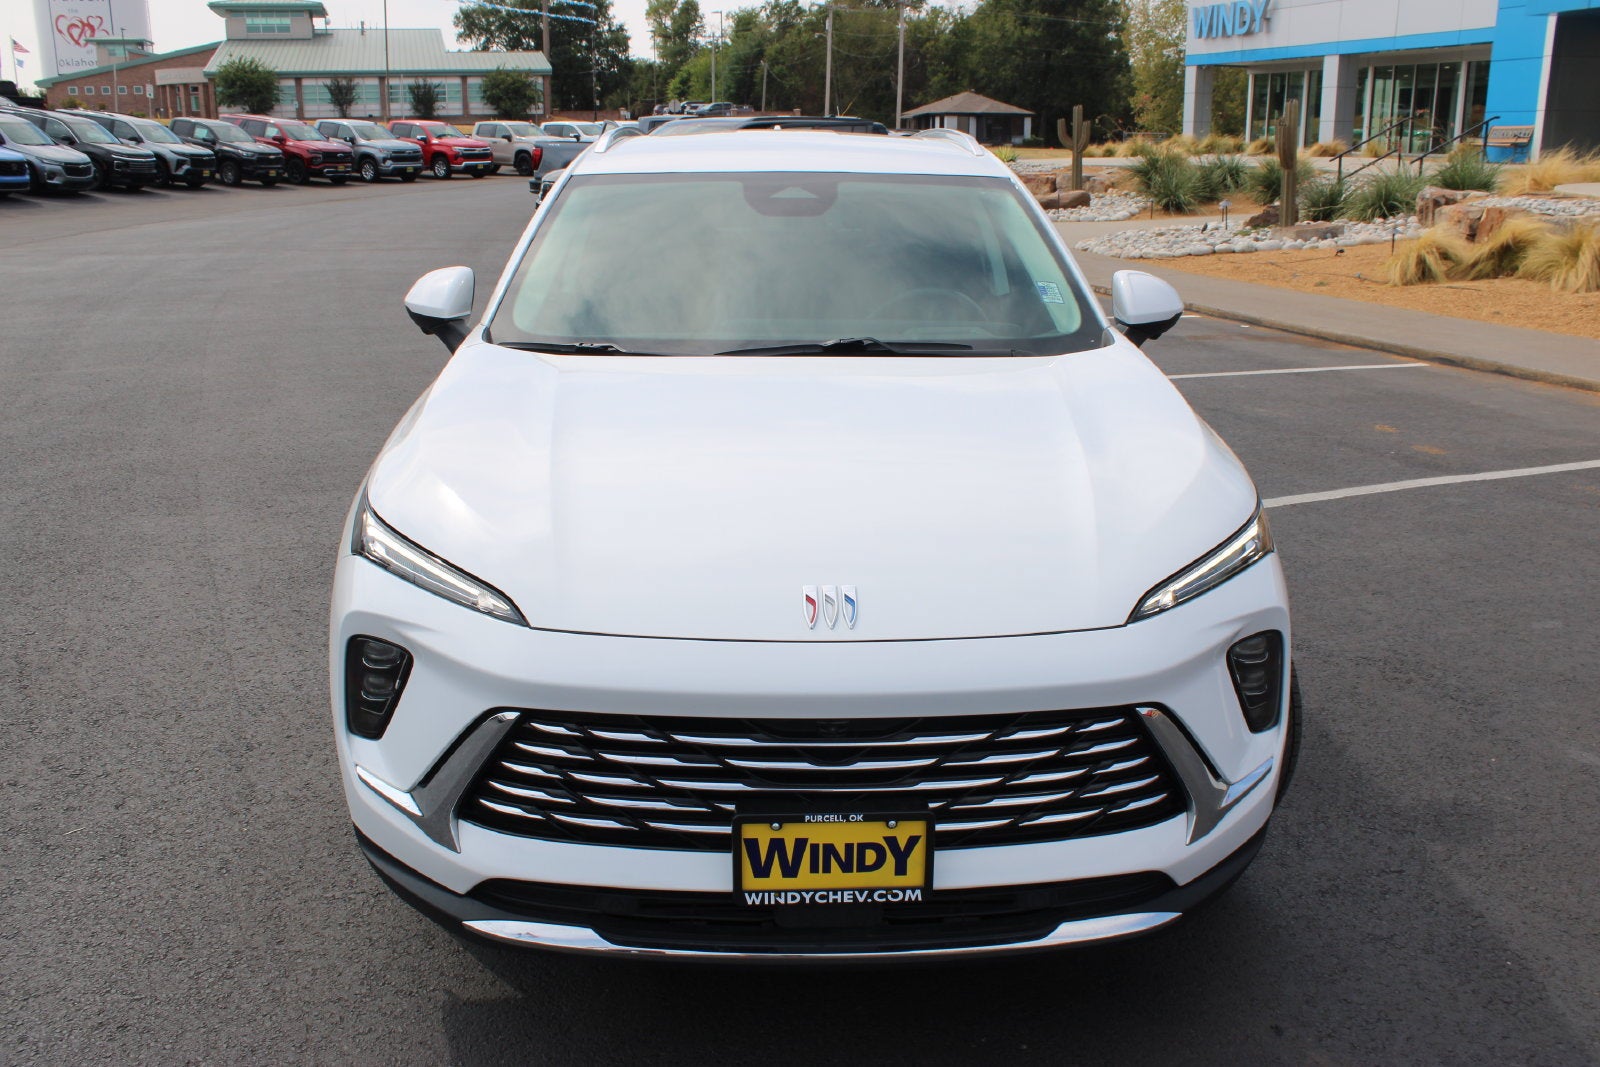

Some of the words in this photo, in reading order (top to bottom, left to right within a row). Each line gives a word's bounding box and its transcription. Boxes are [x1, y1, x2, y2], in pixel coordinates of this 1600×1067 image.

[1193, 0, 1267, 39] WINDY
[58, 58, 98, 68] Oklaho
[804, 814, 847, 823] PURCELL,
[849, 814, 864, 823] OK
[744, 889, 922, 905] WINDYCHEV.COM
